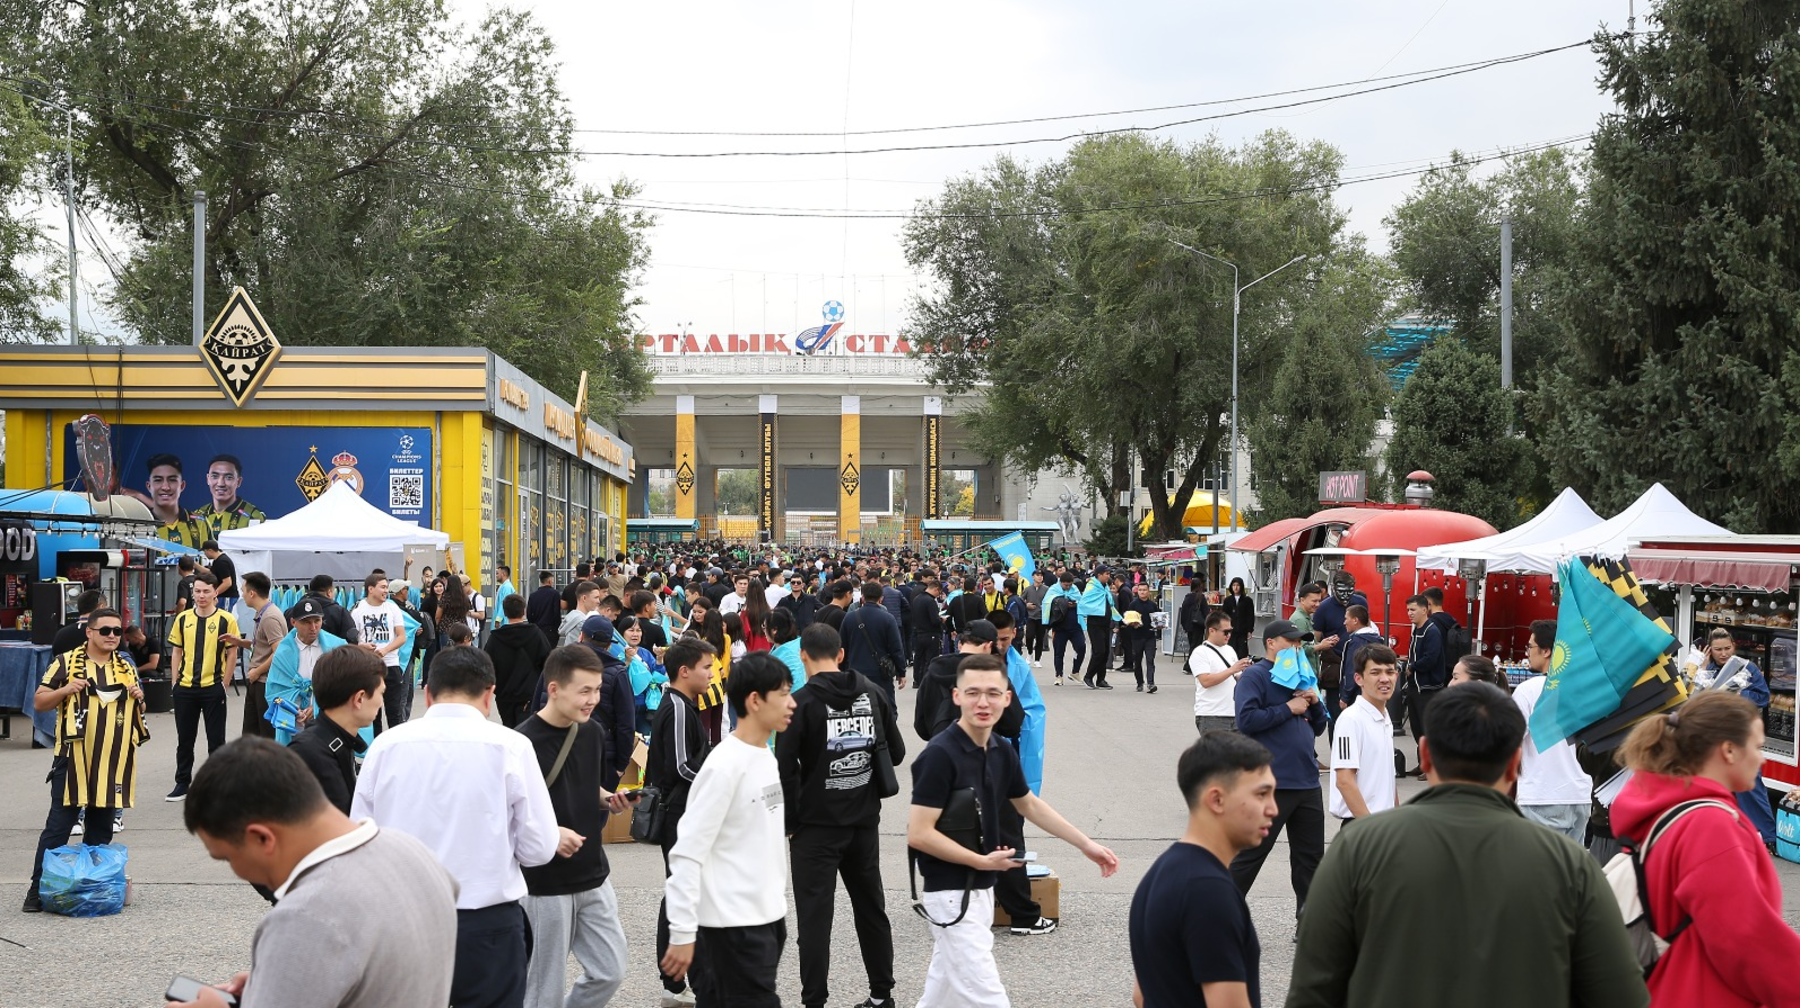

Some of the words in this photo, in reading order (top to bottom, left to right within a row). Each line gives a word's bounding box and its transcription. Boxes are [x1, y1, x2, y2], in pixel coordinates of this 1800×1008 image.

[211, 342, 266, 358] ҚАЙРАТ
[619, 334, 792, 356] РТАЛЫҚ
[764, 423, 772, 453] КЛУБЫ
[929, 418, 937, 466] КОМАНДАСЫ
[764, 455, 772, 489] ФУТБОЛ
[0, 527, 35, 561] OD
